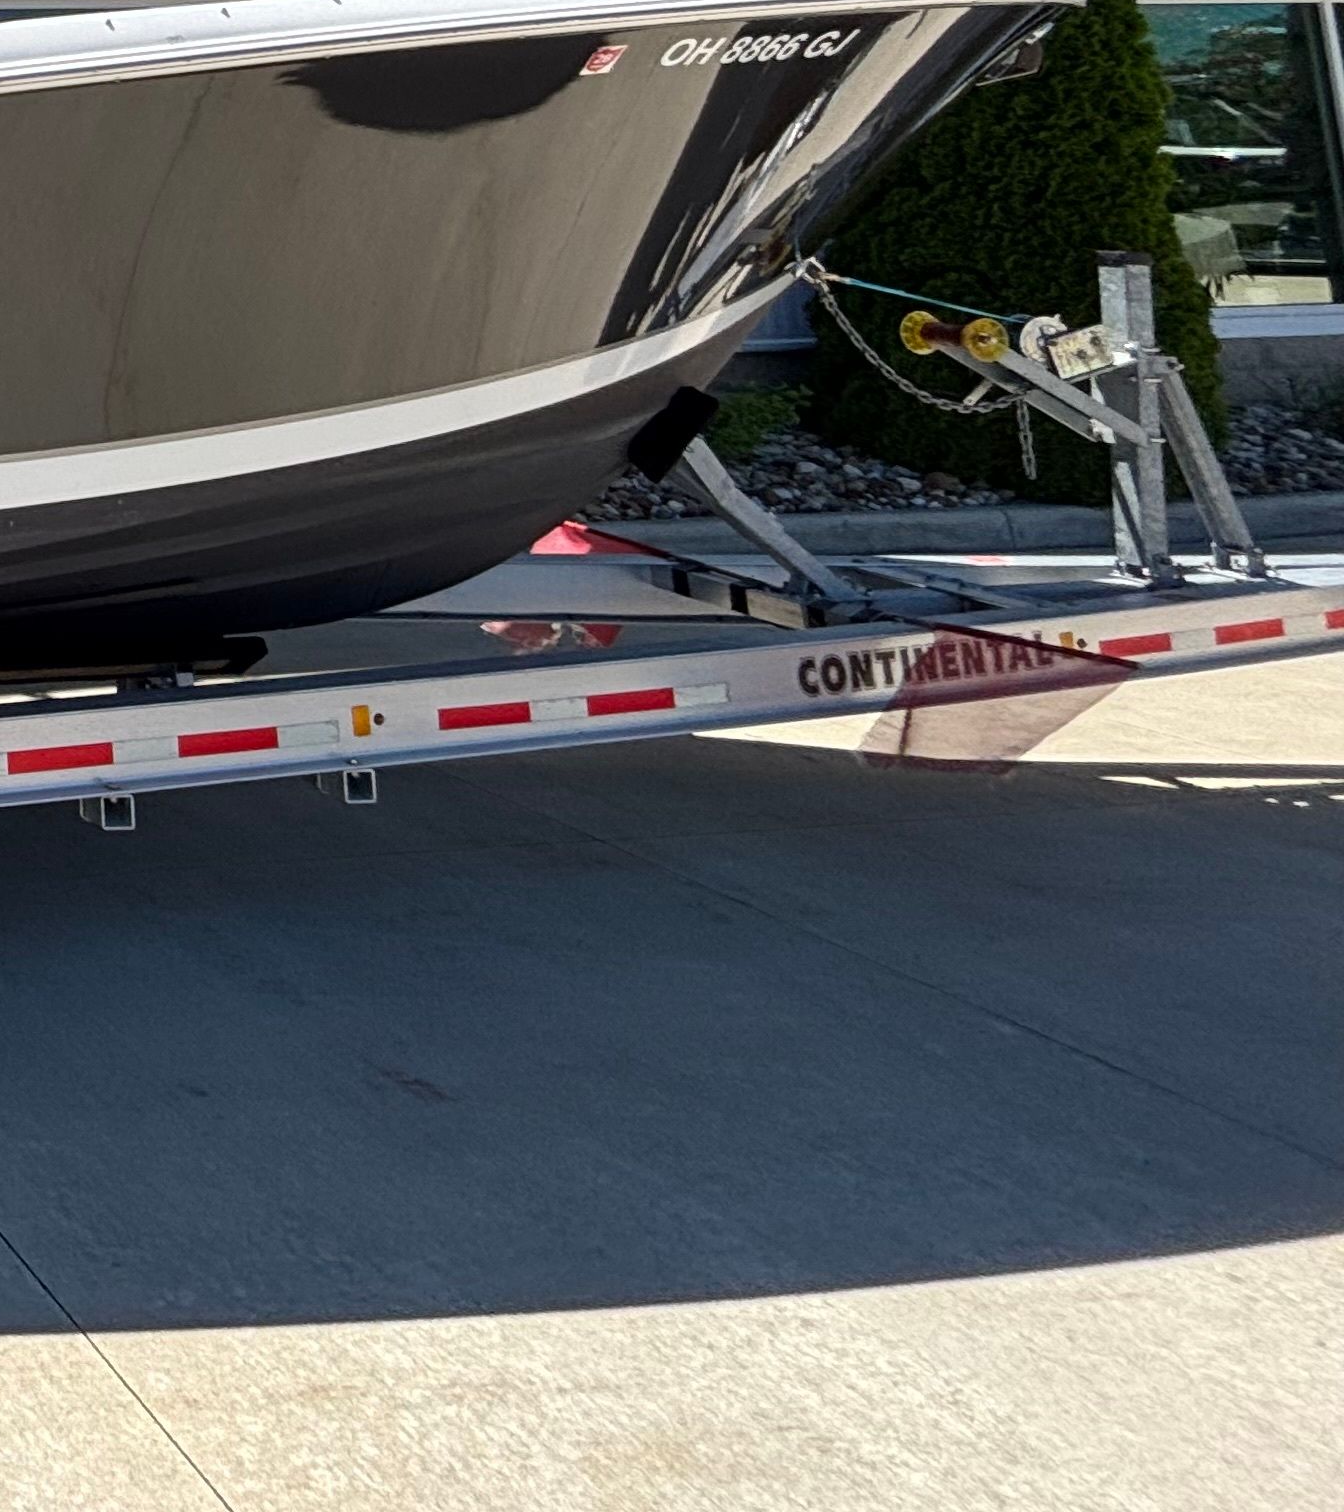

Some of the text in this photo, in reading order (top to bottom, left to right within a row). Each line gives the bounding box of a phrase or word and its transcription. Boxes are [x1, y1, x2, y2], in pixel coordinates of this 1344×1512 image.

[661, 29, 861, 66] OH 8866 GJ
[797, 629, 1056, 696] CONTINENTAL
